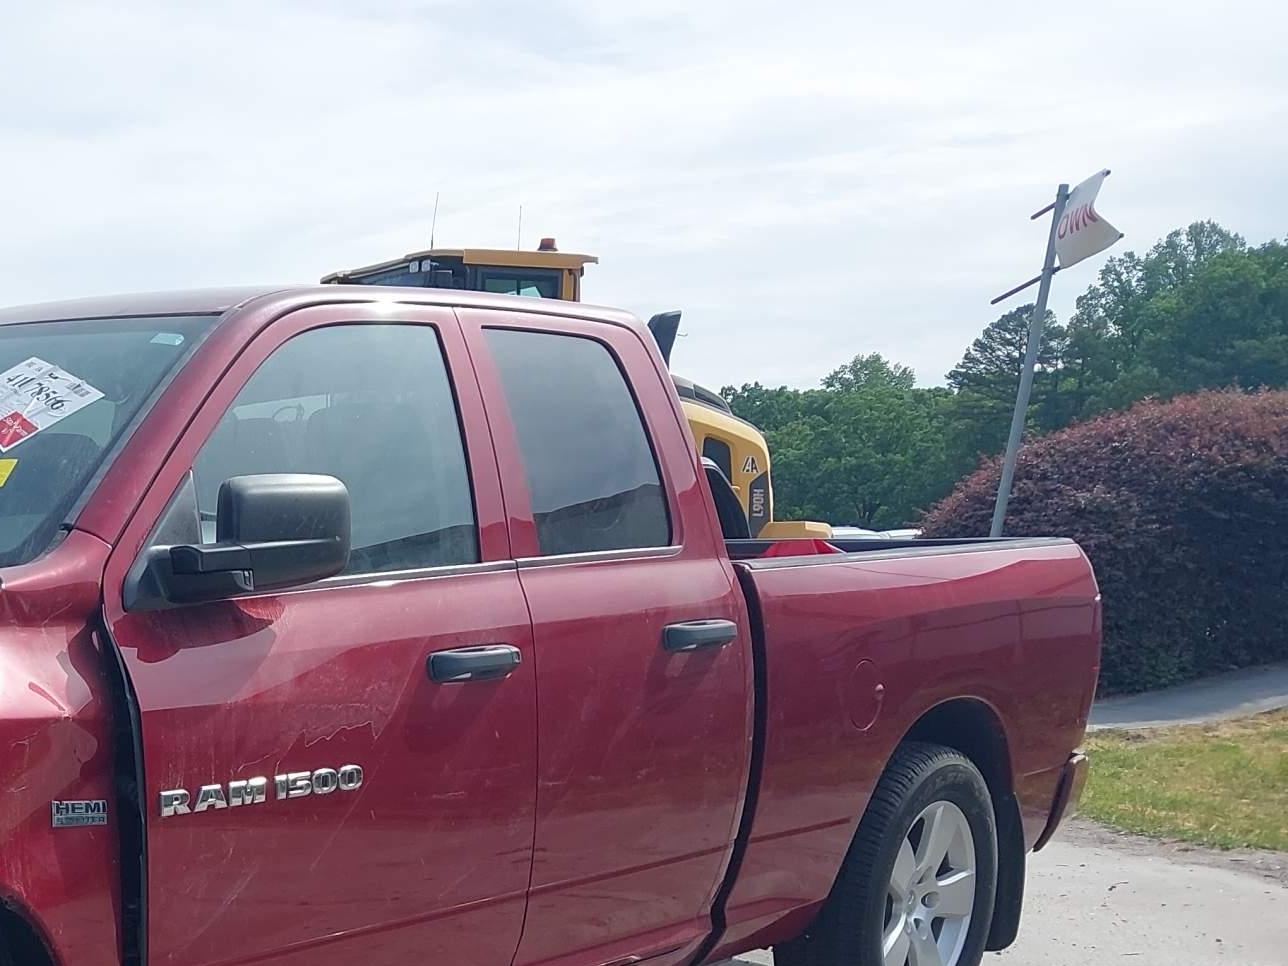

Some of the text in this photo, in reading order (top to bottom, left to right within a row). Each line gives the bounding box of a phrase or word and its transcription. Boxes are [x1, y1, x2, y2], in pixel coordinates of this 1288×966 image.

[753, 488, 765, 518] L90H
[159, 764, 363, 817] RAM 1500
[55, 801, 107, 815] HEMI
